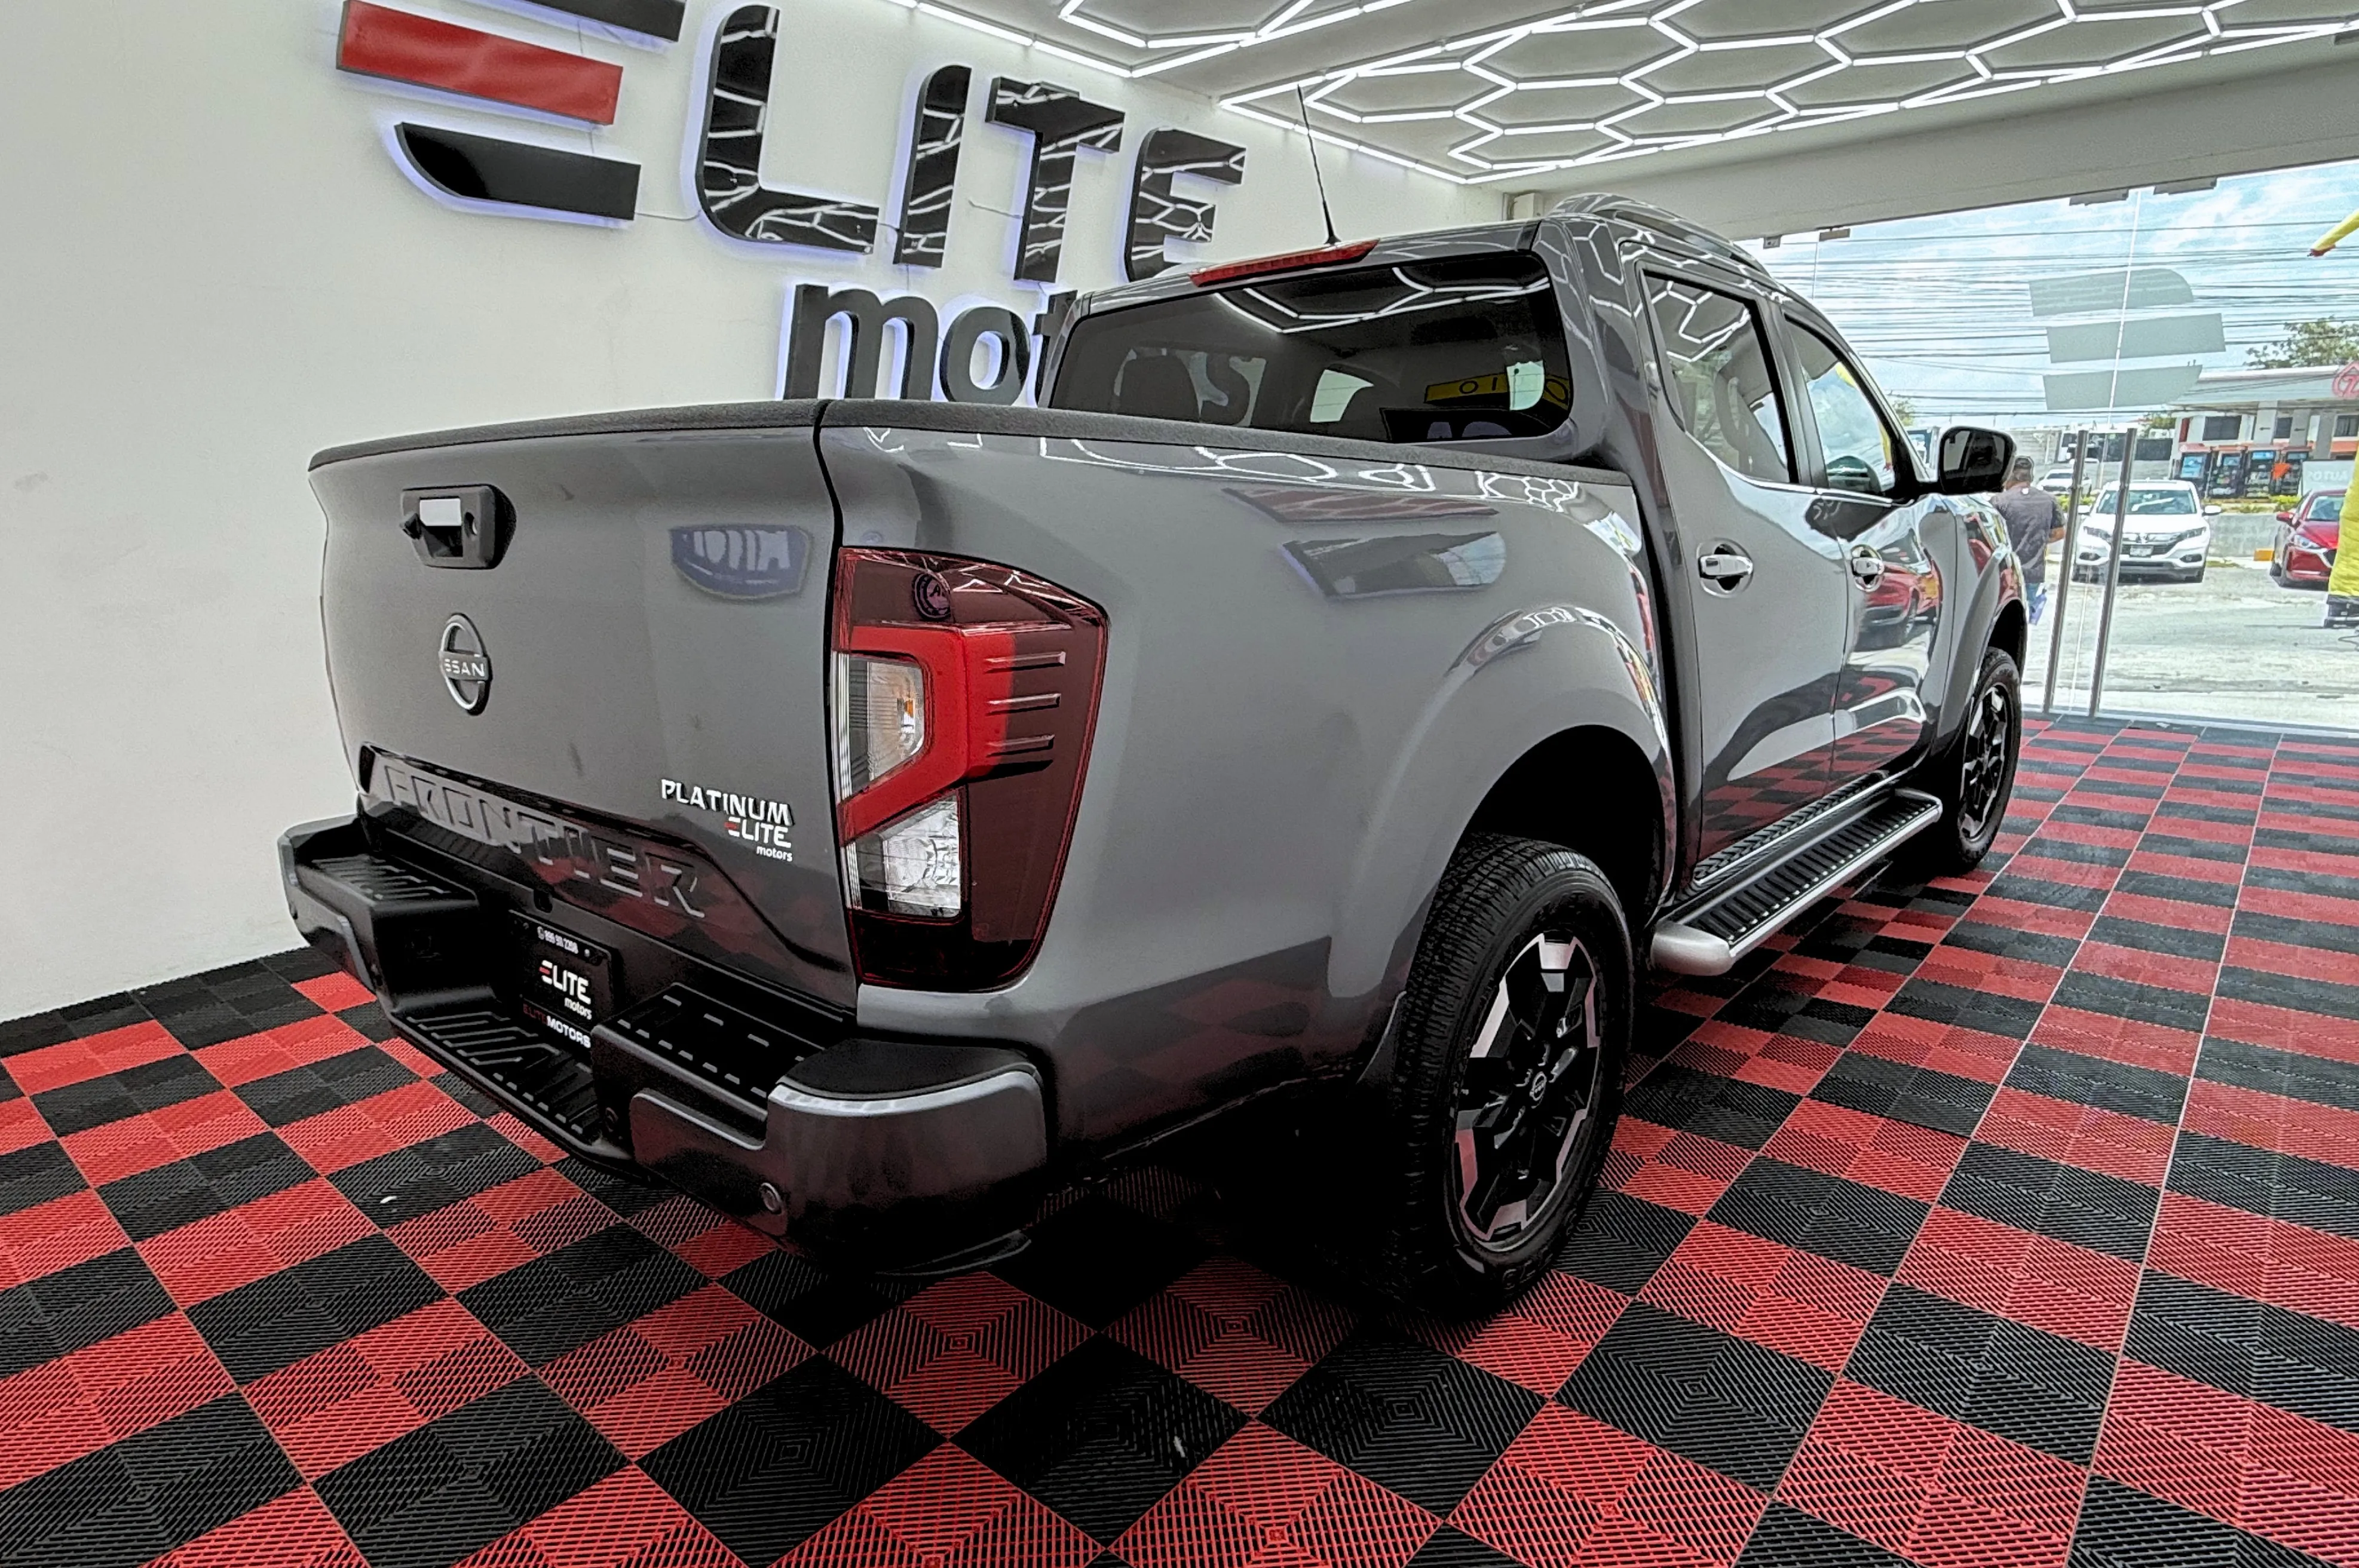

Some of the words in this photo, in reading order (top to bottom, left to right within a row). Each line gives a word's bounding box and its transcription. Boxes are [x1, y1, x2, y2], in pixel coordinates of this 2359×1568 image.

[336, 0, 1246, 283] ELITE
[444, 658, 485, 677] SSAN
[661, 779, 794, 826] PLATINUM
[384, 765, 705, 918] FRONTIER
[724, 816, 792, 848] ELITE
[756, 846, 793, 862] motors
[539, 960, 591, 1005] ELITE
[563, 997, 592, 1020] motors
